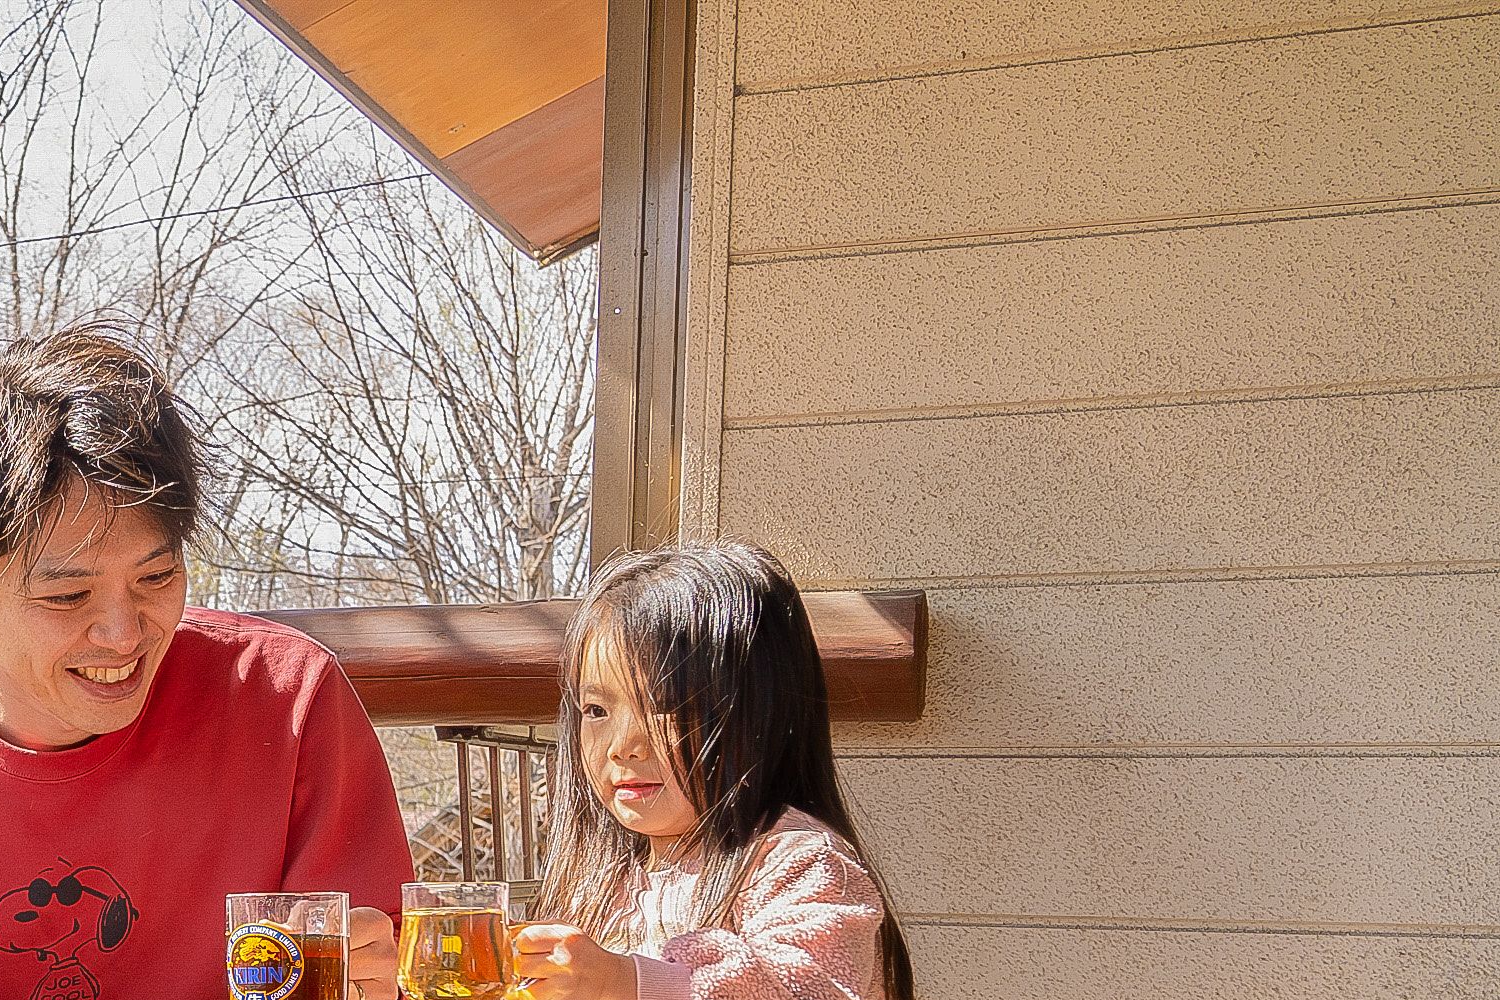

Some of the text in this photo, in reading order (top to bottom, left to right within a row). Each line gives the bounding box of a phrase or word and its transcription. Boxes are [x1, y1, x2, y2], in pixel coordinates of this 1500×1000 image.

[278, 935, 298, 957] LIMITED
[45, 975, 81, 991] JOE
[233, 966, 283, 985] KIRIN
[270, 988, 287, 1000] GOOD
[284, 972, 299, 990] TIMES
